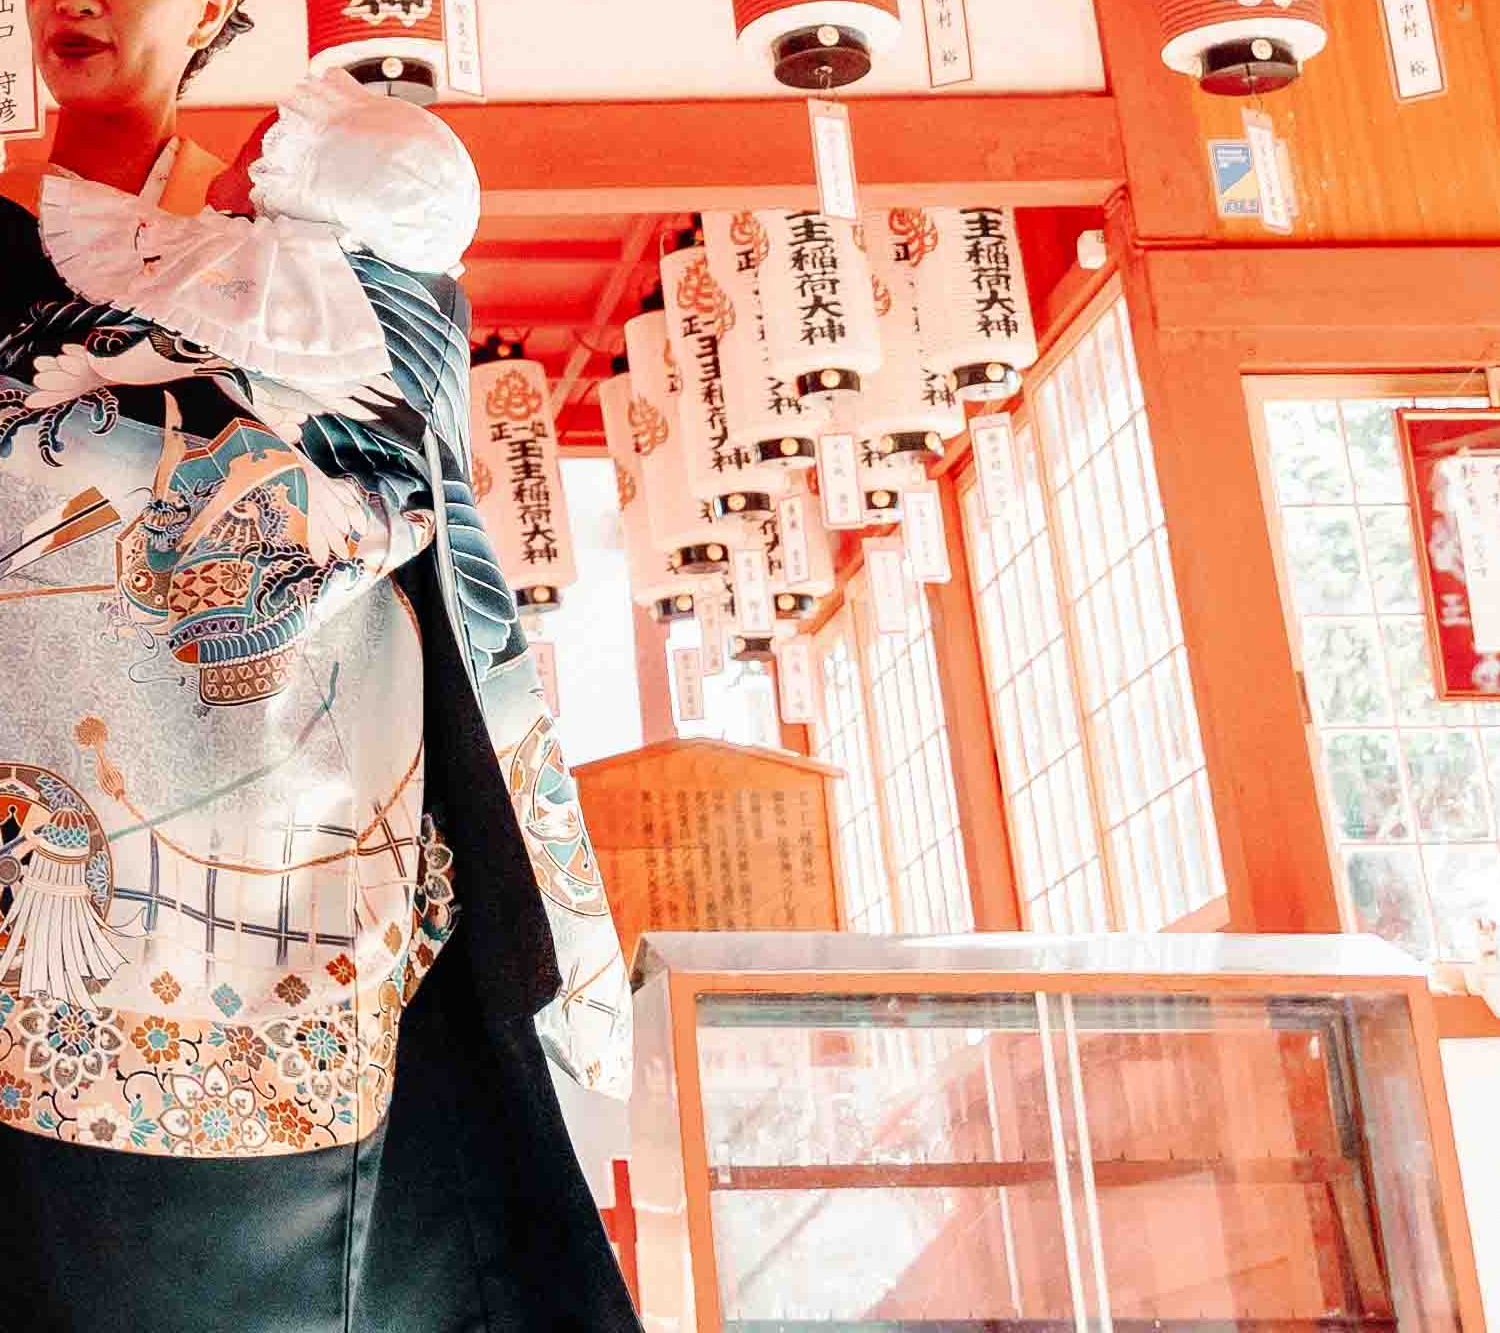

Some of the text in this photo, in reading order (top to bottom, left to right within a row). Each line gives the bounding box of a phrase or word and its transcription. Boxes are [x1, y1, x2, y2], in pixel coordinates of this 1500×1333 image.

[785, 211, 846, 346] 主稲荷大神
[958, 207, 1020, 339] 主稲荷大神
[505, 438, 560, 565] 玉主稲荷大神
